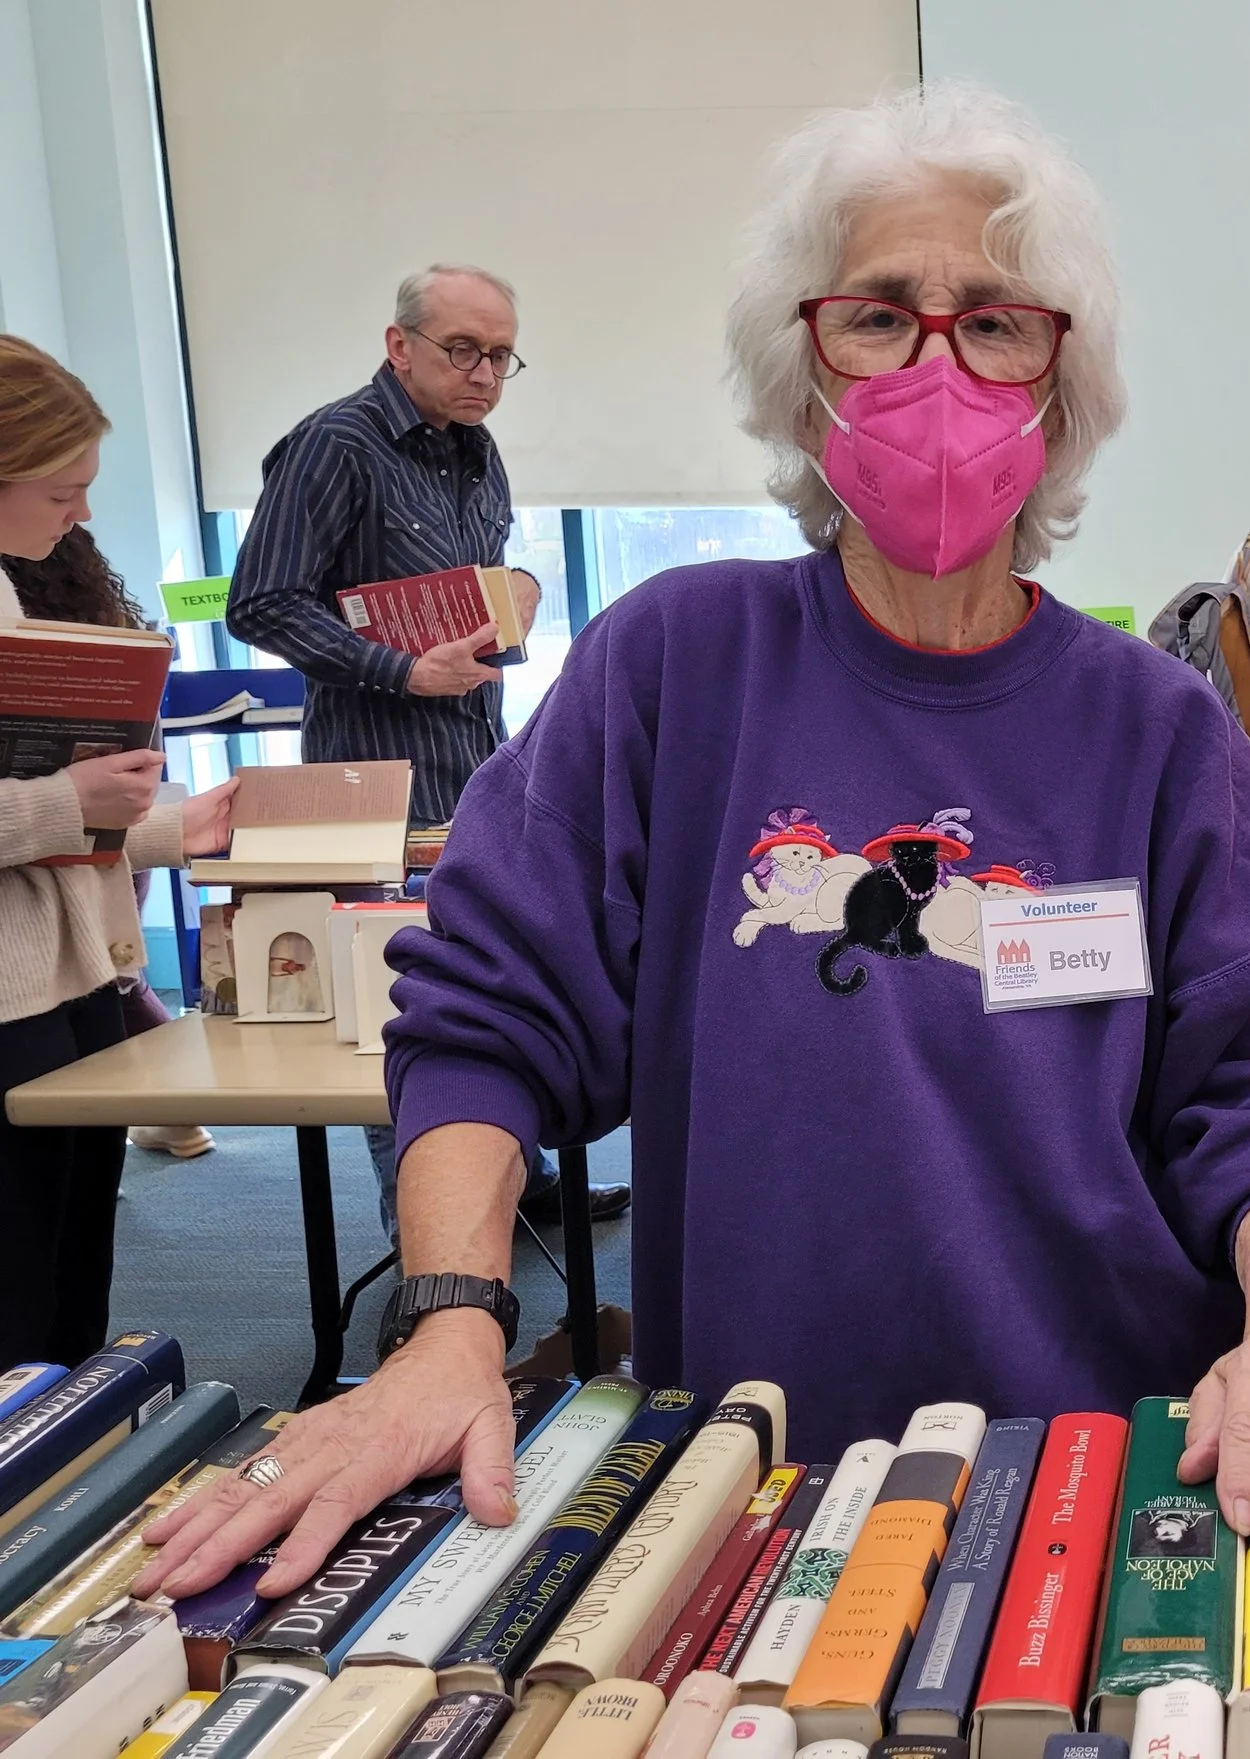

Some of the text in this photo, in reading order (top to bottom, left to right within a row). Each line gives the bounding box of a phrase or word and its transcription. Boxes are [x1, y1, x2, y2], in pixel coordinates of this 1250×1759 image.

[1021, 901, 1098, 918] Volunteer
[995, 963, 1036, 974] Friends
[1049, 948, 1112, 972] Betty
[653, 1389, 697, 1401] VIKING
[553, 1422, 601, 1431] JOHN
[558, 1413, 608, 1425] GLATT
[704, 1413, 752, 1423] PETE
[923, 1413, 964, 1421] NORTON
[995, 1424, 1030, 1432] VIKING
[995, 1464, 1021, 1498] Reagan
[1051, 1426, 1092, 1528] The Mosquito Bowl
[53, 1487, 90, 1513] KOHLI
[627, 1475, 698, 1538] CENTURY
[1155, 1495, 1197, 1503] DURANT
[809, 1497, 840, 1543] IRISH ON
[832, 1486, 868, 1543] THE INSIDE
[946, 1464, 1000, 1575] When Character Was King
[986, 1493, 1009, 1527] Ronald
[398, 1575, 441, 1607] MY
[432, 1519, 491, 1570] SWEE
[511, 1445, 554, 1499] NGEL
[870, 1517, 933, 1527] DIAMOND
[875, 1532, 915, 1542] JARED
[974, 1535, 1001, 1564] Story
[271, 1513, 425, 1634] DISCIPLES
[1125, 1559, 1216, 1572] NAPOLEON
[1140, 1569, 1198, 1580] AGE OF
[1151, 1579, 1187, 1591] THE
[462, 1547, 550, 1651] WILLIAM COHEN
[491, 1551, 582, 1661] GEORGE MITCHELL
[701, 1650, 719, 1672] THE
[716, 1616, 738, 1651] NEXT
[732, 1574, 762, 1624] AMERICAN
[757, 1528, 792, 1579] REVOLUTION
[719, 1529, 803, 1673] SUSTAINABLE ACTIVISM FOR TWENTY-FIRST CENTURY
[848, 1607, 877, 1616] AND
[1018, 1570, 1066, 1671] Buzz Bissinger
[769, 1603, 802, 1651] HAYDEN
[653, 1632, 694, 1686] OROONOKO
[925, 1641, 950, 1685] PEGGY
[584, 1694, 639, 1708] BROWN
[578, 1708, 632, 1721] LITTLE
[883, 1745, 948, 1754] RANDOM HOUSE
[1063, 1745, 1100, 1753] BOOKS
[1063, 1751, 1099, 1759] NATION
